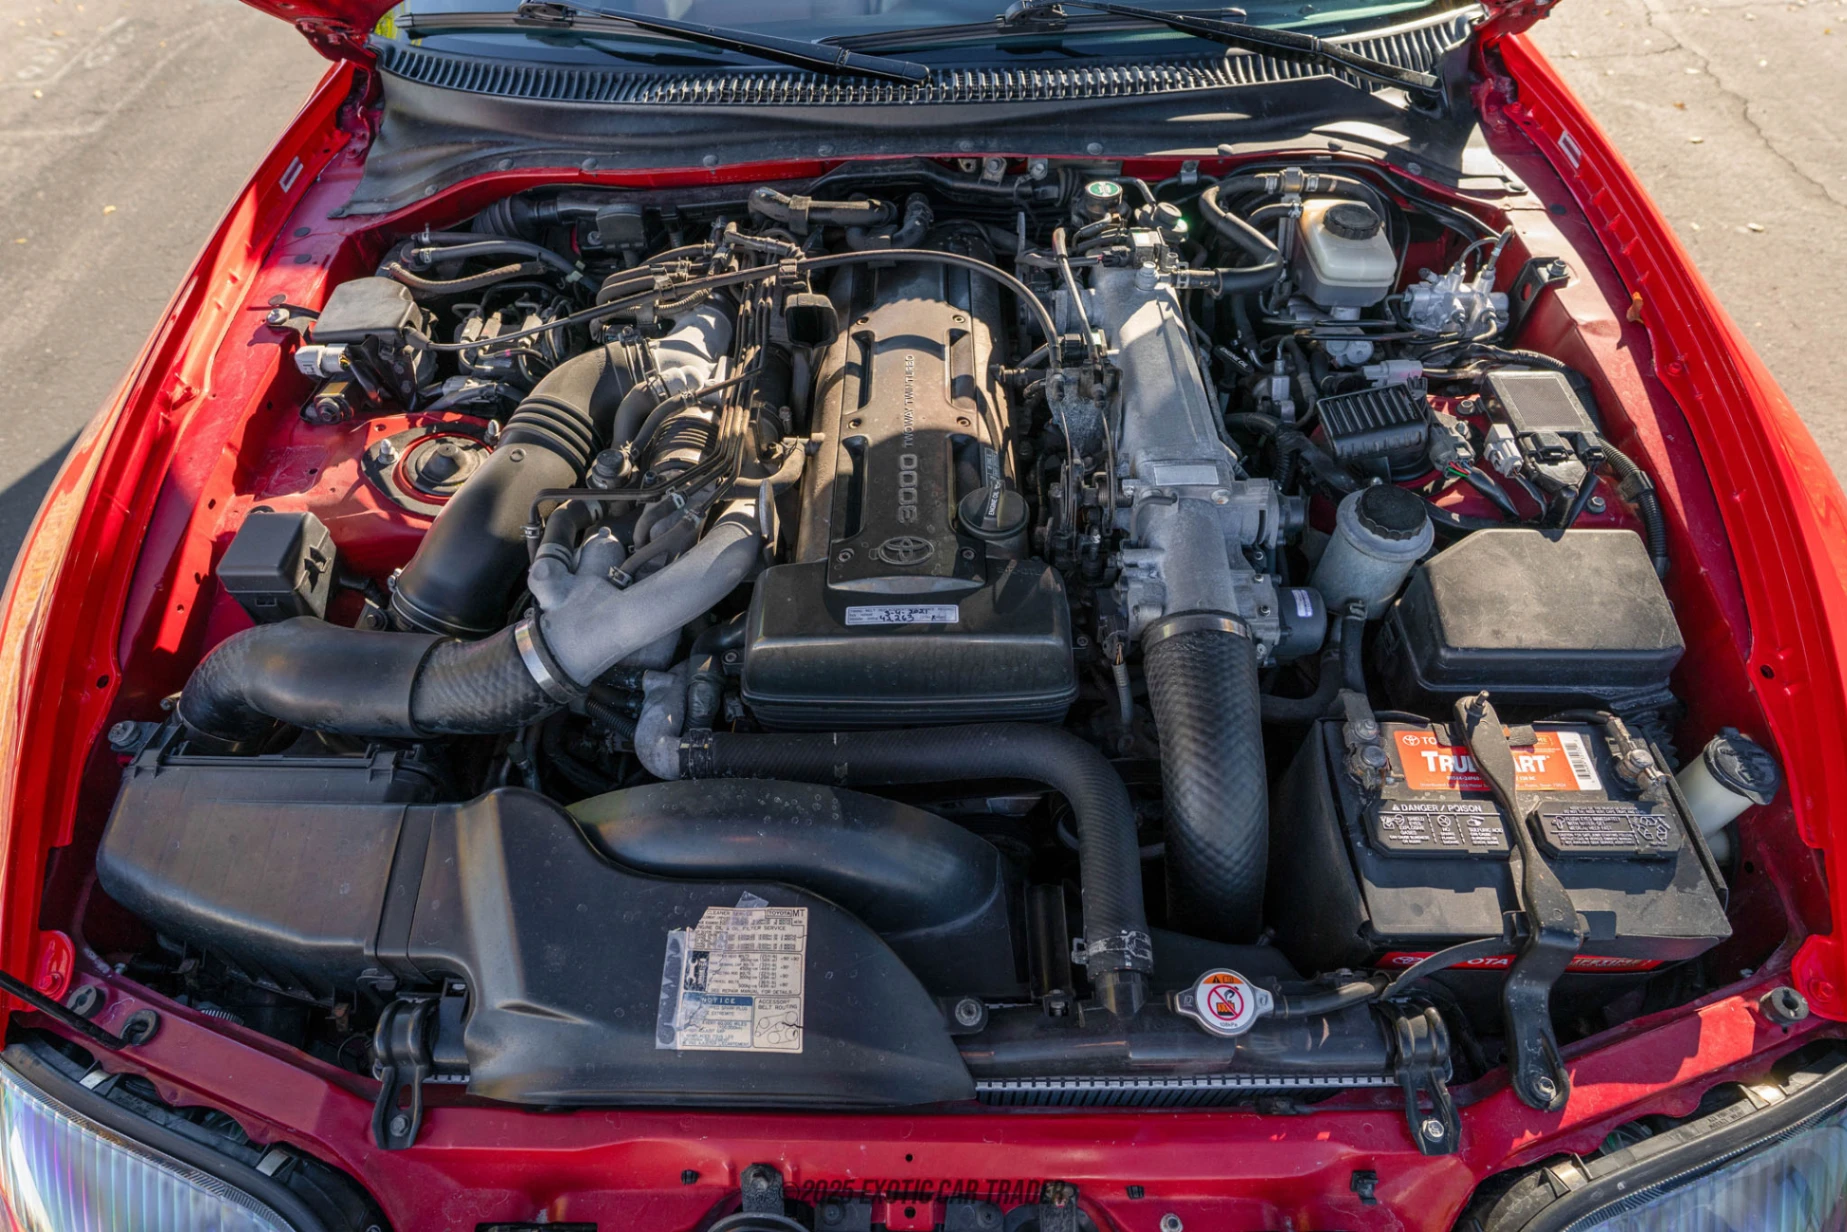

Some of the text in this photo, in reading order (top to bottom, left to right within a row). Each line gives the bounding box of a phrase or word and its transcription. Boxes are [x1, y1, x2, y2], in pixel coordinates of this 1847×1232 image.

[898, 453, 918, 525] 3000
[988, 499, 998, 516] ENGINE
[1448, 804, 1482, 812] POISON
[792, 909, 805, 917] MT
